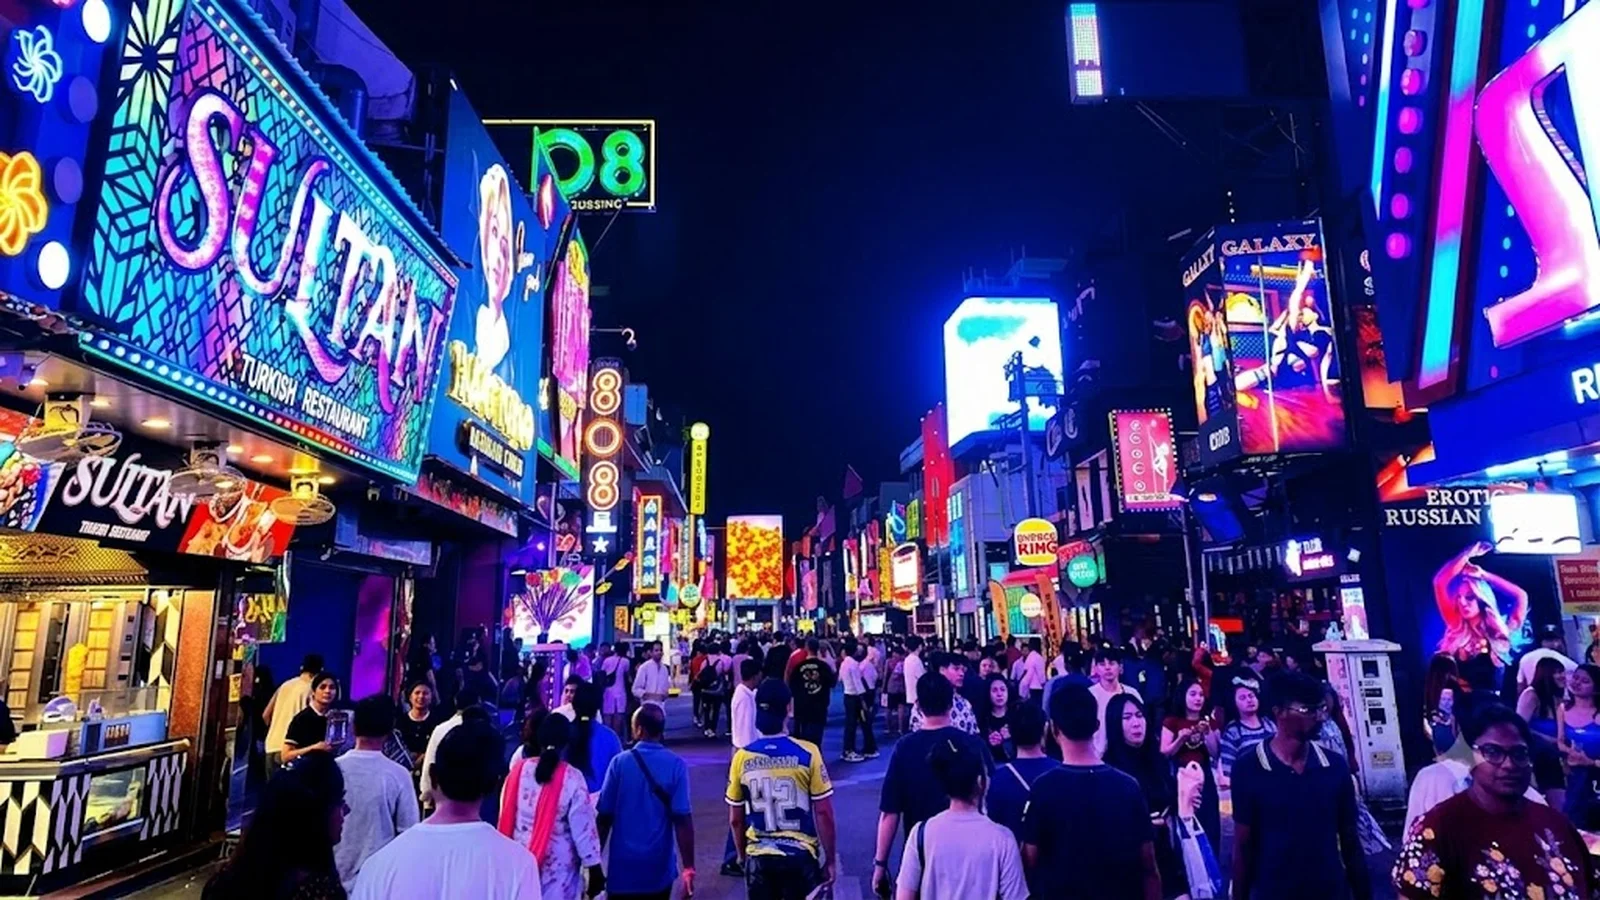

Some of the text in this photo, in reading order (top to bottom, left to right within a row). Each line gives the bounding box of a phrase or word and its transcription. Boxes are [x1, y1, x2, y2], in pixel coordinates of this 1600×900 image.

[156, 91, 445, 414] SULTAN
[1221, 233, 1316, 256] GALAXY
[240, 353, 370, 442] TURKISH RESTAURANT
[62, 452, 197, 529] SULTAN
[1384, 508, 1481, 526] RUSSIAN
[1425, 489, 1505, 506] EROTI
[750, 776, 800, 833] 42
